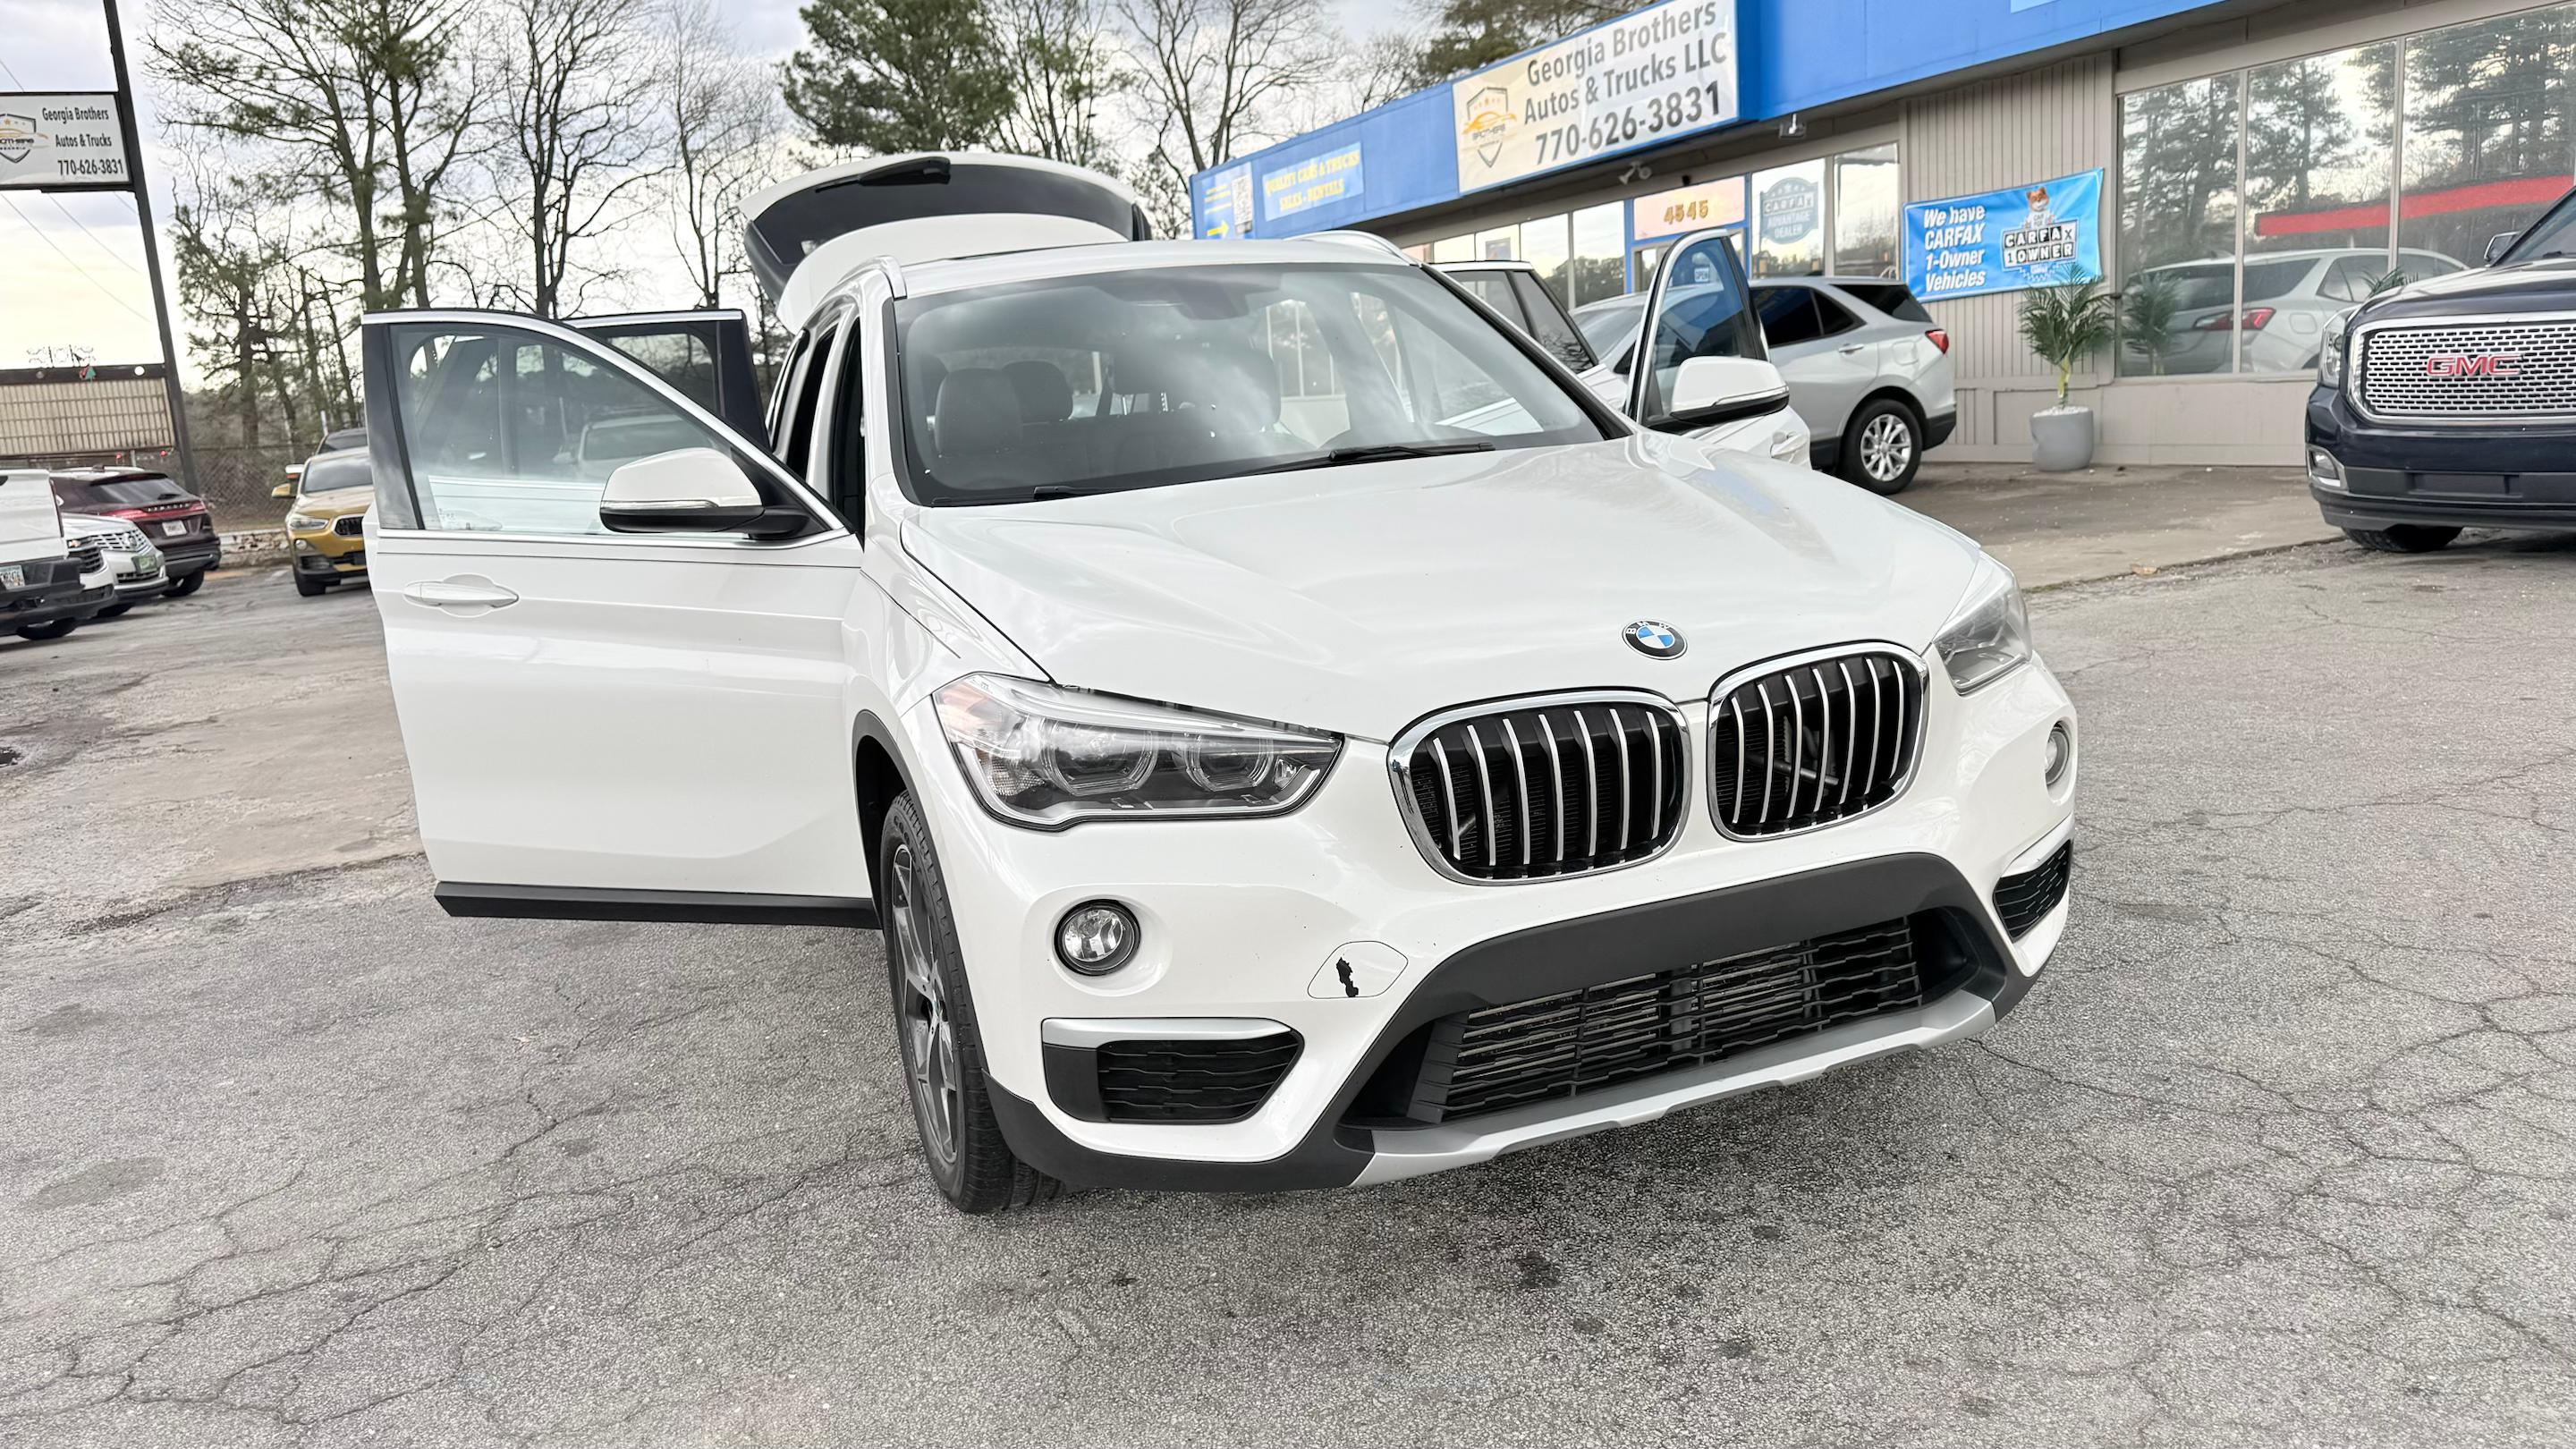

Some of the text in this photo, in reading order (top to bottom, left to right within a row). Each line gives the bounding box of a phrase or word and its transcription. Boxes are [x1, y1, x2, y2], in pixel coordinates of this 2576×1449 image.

[1527, 2, 1716, 86] Georgia Brothers
[1524, 32, 1728, 125] Autos & Trucks LLC
[42, 106, 109, 124] Georgia Brothers
[1535, 80, 1720, 165] 770-626-3831
[55, 133, 112, 148] Autos & Trucks
[57, 158, 123, 176] 770-626-3831
[1664, 199, 1708, 225] 4545
[1765, 195, 1813, 214] CARFAX
[1924, 205, 1986, 228] We have
[1775, 224, 1803, 238] DEALER
[1924, 223, 1986, 250] CARFAX
[2004, 227, 2072, 247] CARFAX
[1926, 249, 1985, 271] 1-Owner
[2007, 243, 2072, 263] 1 OWNER
[1925, 270, 1986, 292] Vehicles
[2427, 354, 2522, 377] GMC
